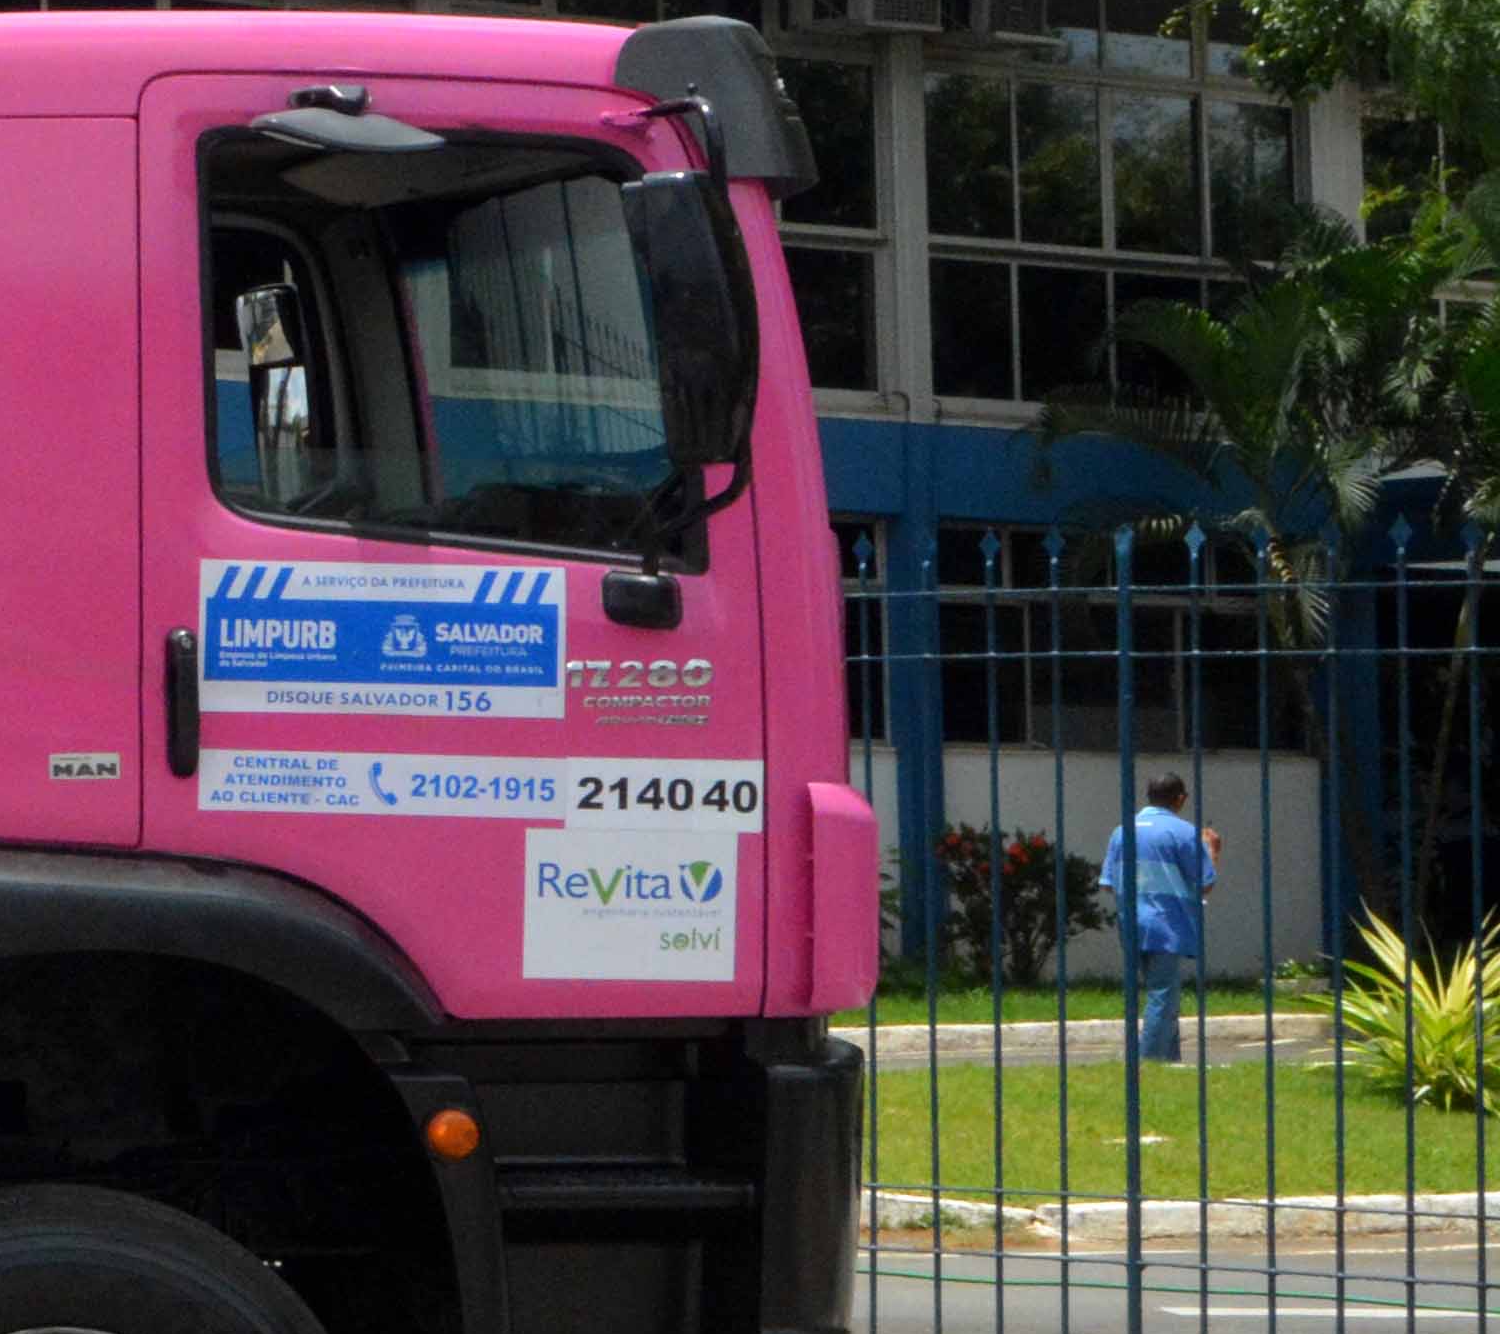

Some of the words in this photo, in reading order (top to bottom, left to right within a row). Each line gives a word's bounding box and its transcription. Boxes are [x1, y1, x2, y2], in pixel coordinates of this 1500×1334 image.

[301, 575, 312, 587] A
[315, 575, 367, 589] SERVIÇO
[371, 576, 389, 588] DA
[392, 577, 466, 589] PREFEITURA
[219, 618, 337, 649] LIMPURB
[435, 622, 544, 645] SALVADOR
[450, 644, 529, 658] PREFEITURA
[266, 690, 333, 706] DISQUE
[340, 691, 438, 707] SALVADOR
[445, 691, 492, 712] 156
[583, 695, 711, 708] COMPACTOR
[53, 763, 117, 777] MAN
[233, 756, 311, 770] CENTRAL
[317, 758, 339, 771] DE
[224, 773, 347, 788] ATENDIMENTO
[411, 773, 556, 802] 2102-1915
[210, 790, 234, 803] AO
[239, 791, 312, 805] CLIENTE
[326, 794, 360, 806] CAC
[537, 861, 672, 905] ReVita
